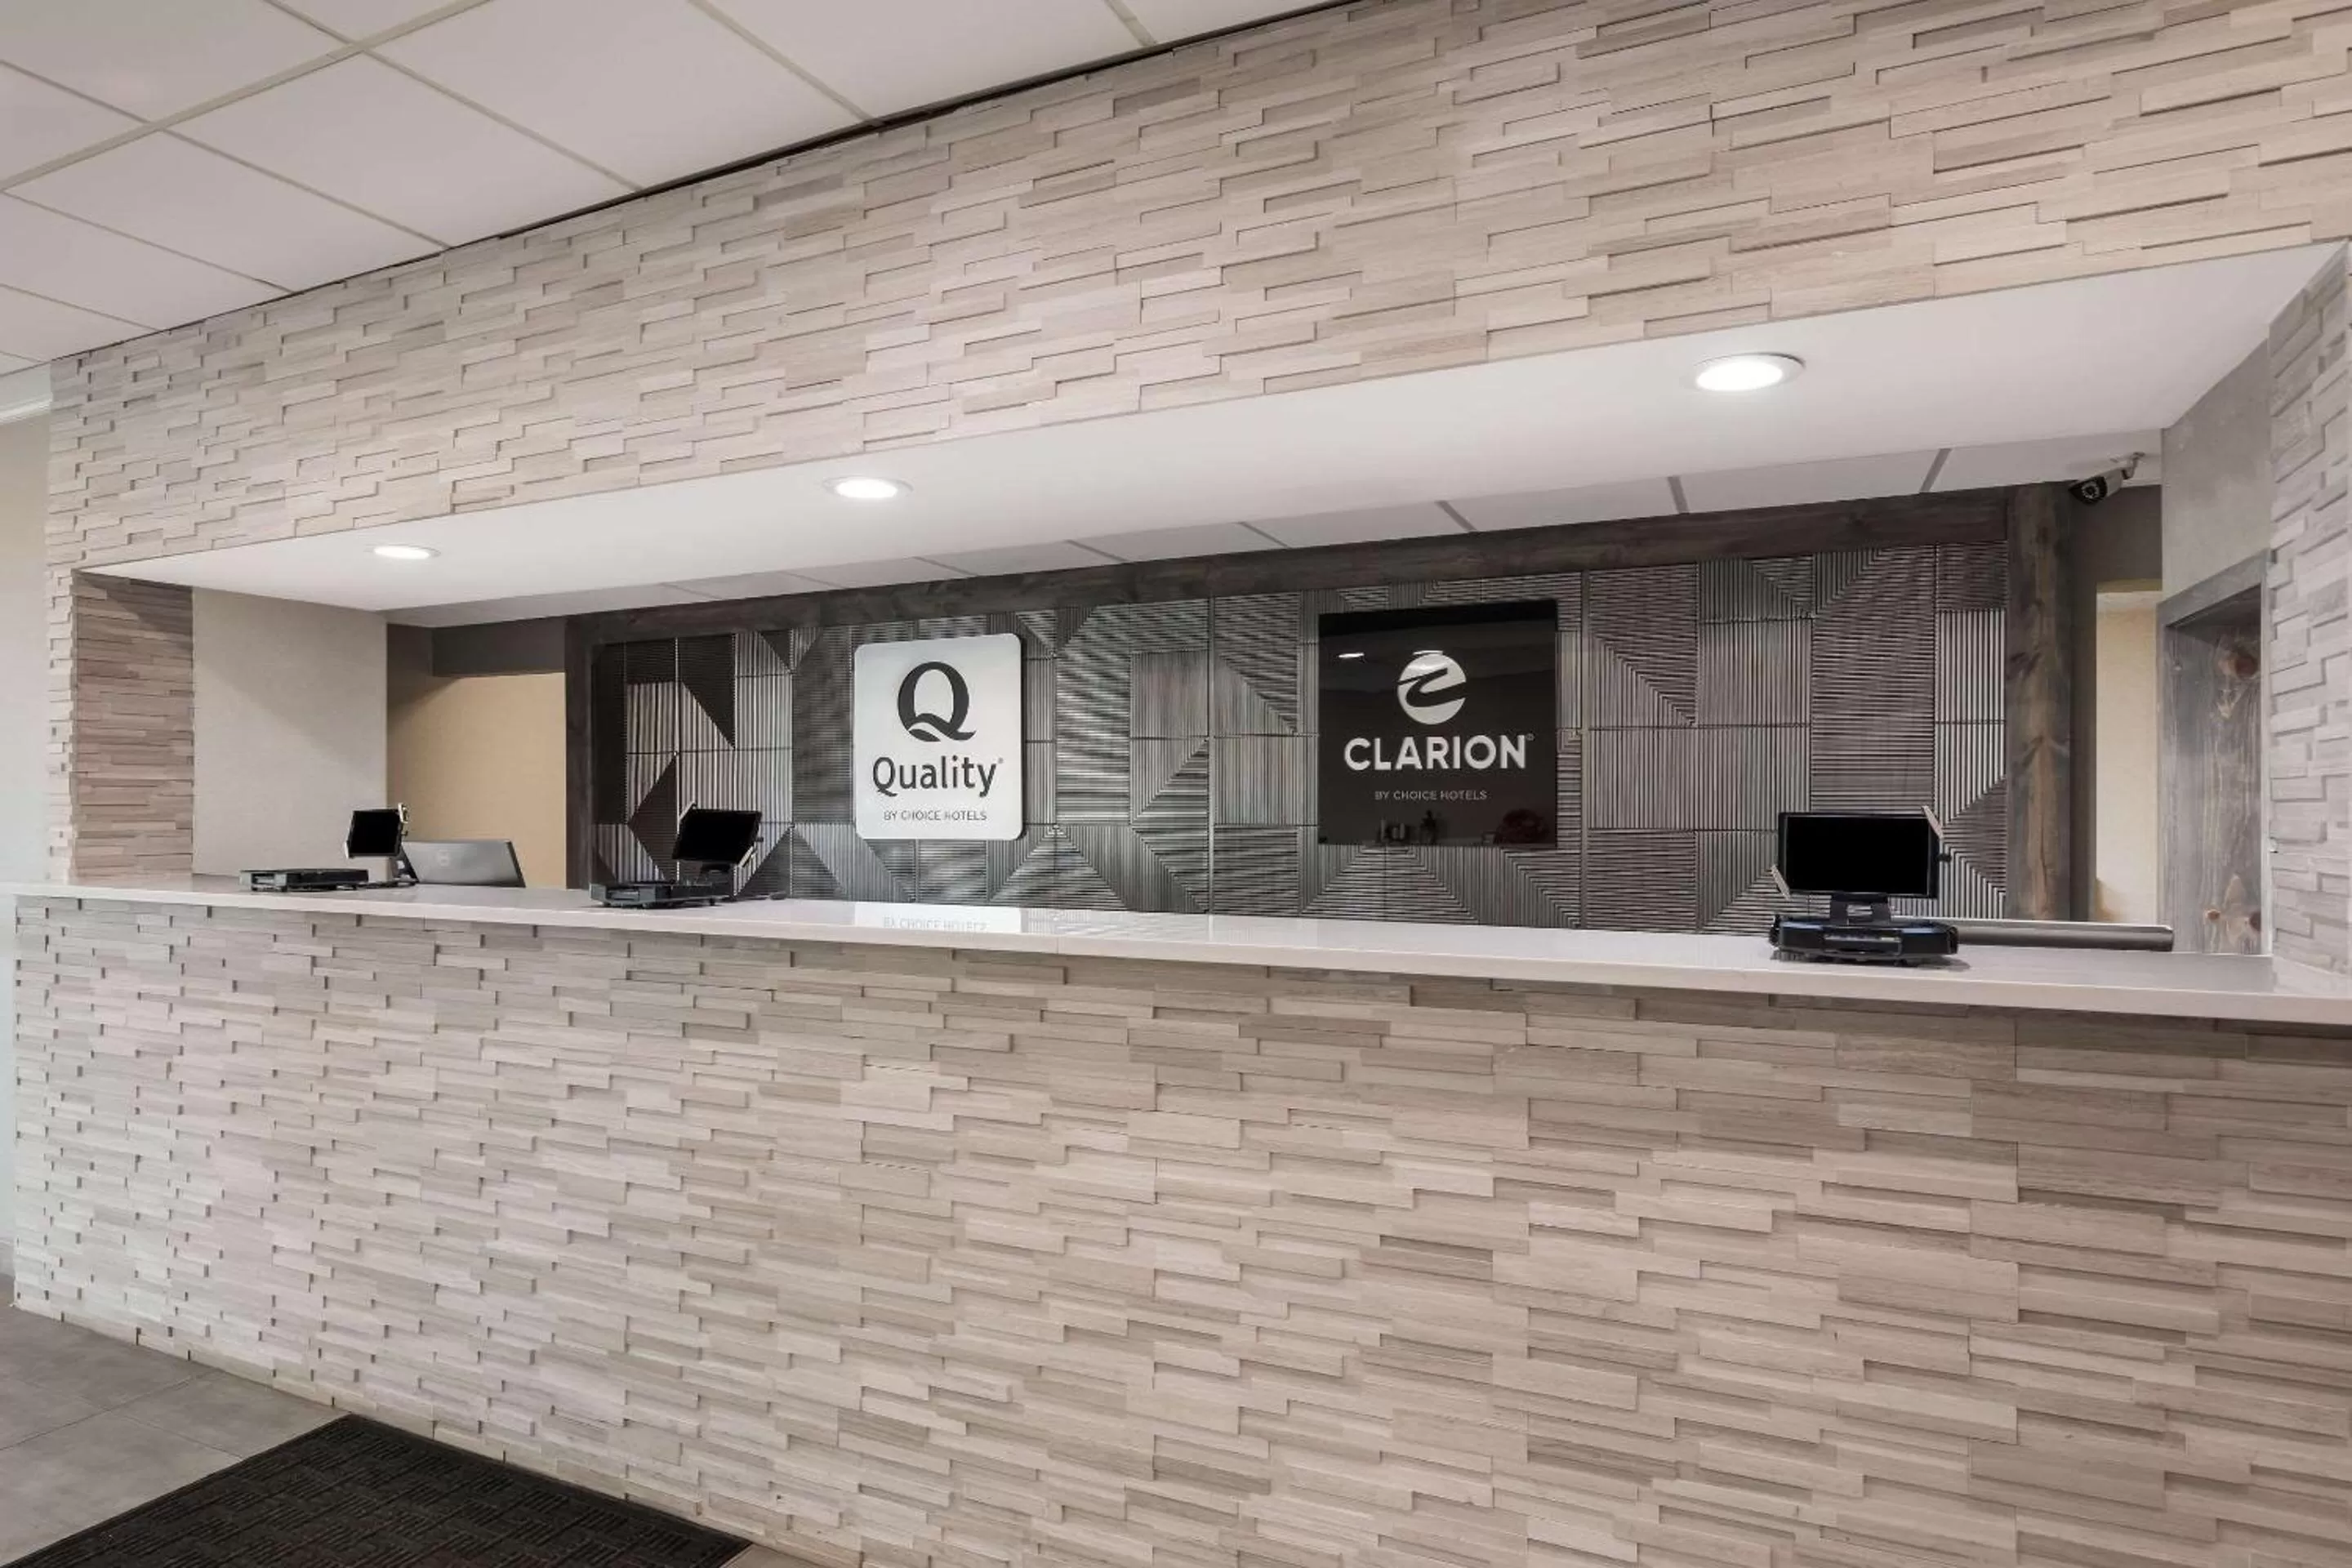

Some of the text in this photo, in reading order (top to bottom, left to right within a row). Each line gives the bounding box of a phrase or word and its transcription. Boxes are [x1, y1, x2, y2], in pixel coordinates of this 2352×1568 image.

[898, 661, 977, 742] Q
[1343, 734, 1526, 771] CLARION
[872, 755, 997, 798] Quality
[1374, 790, 1487, 800] BY CHOICE HOTELS
[884, 809, 987, 821] BY CHOICE HOTELS
